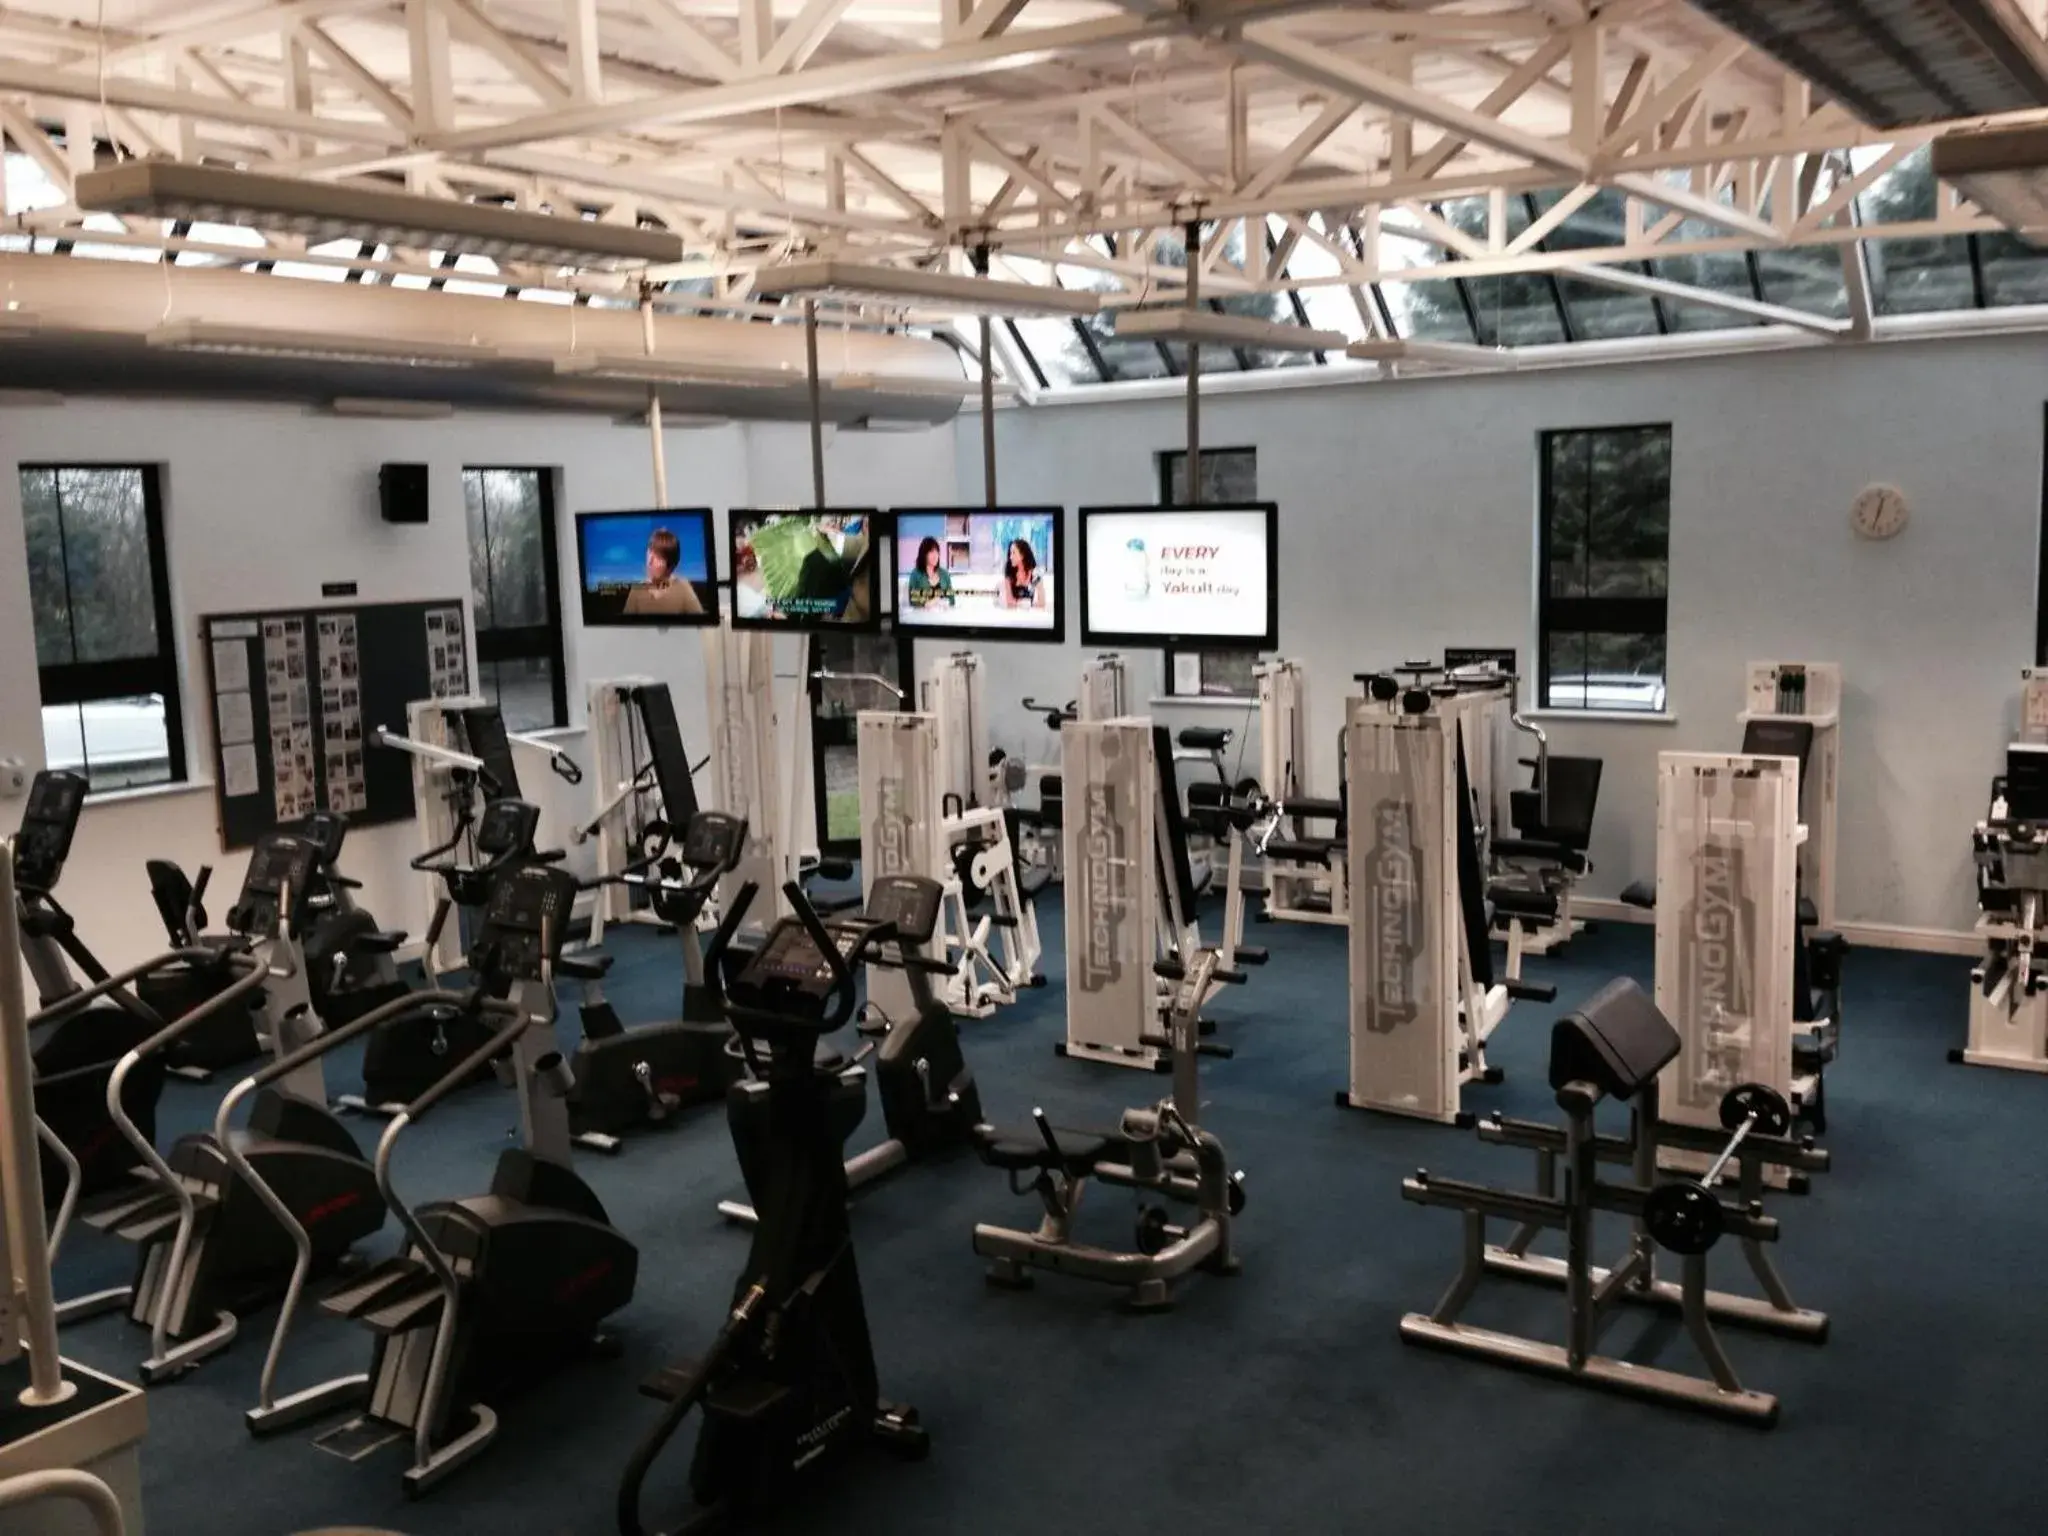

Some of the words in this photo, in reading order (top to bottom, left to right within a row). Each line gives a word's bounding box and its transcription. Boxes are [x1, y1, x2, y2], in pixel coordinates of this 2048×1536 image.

[1160, 546, 1220, 559] EVERY
[1162, 582, 1213, 595] Yakult
[1083, 790, 1117, 989] TECHNOGYM
[1372, 808, 1412, 1029] TECHNOGYM
